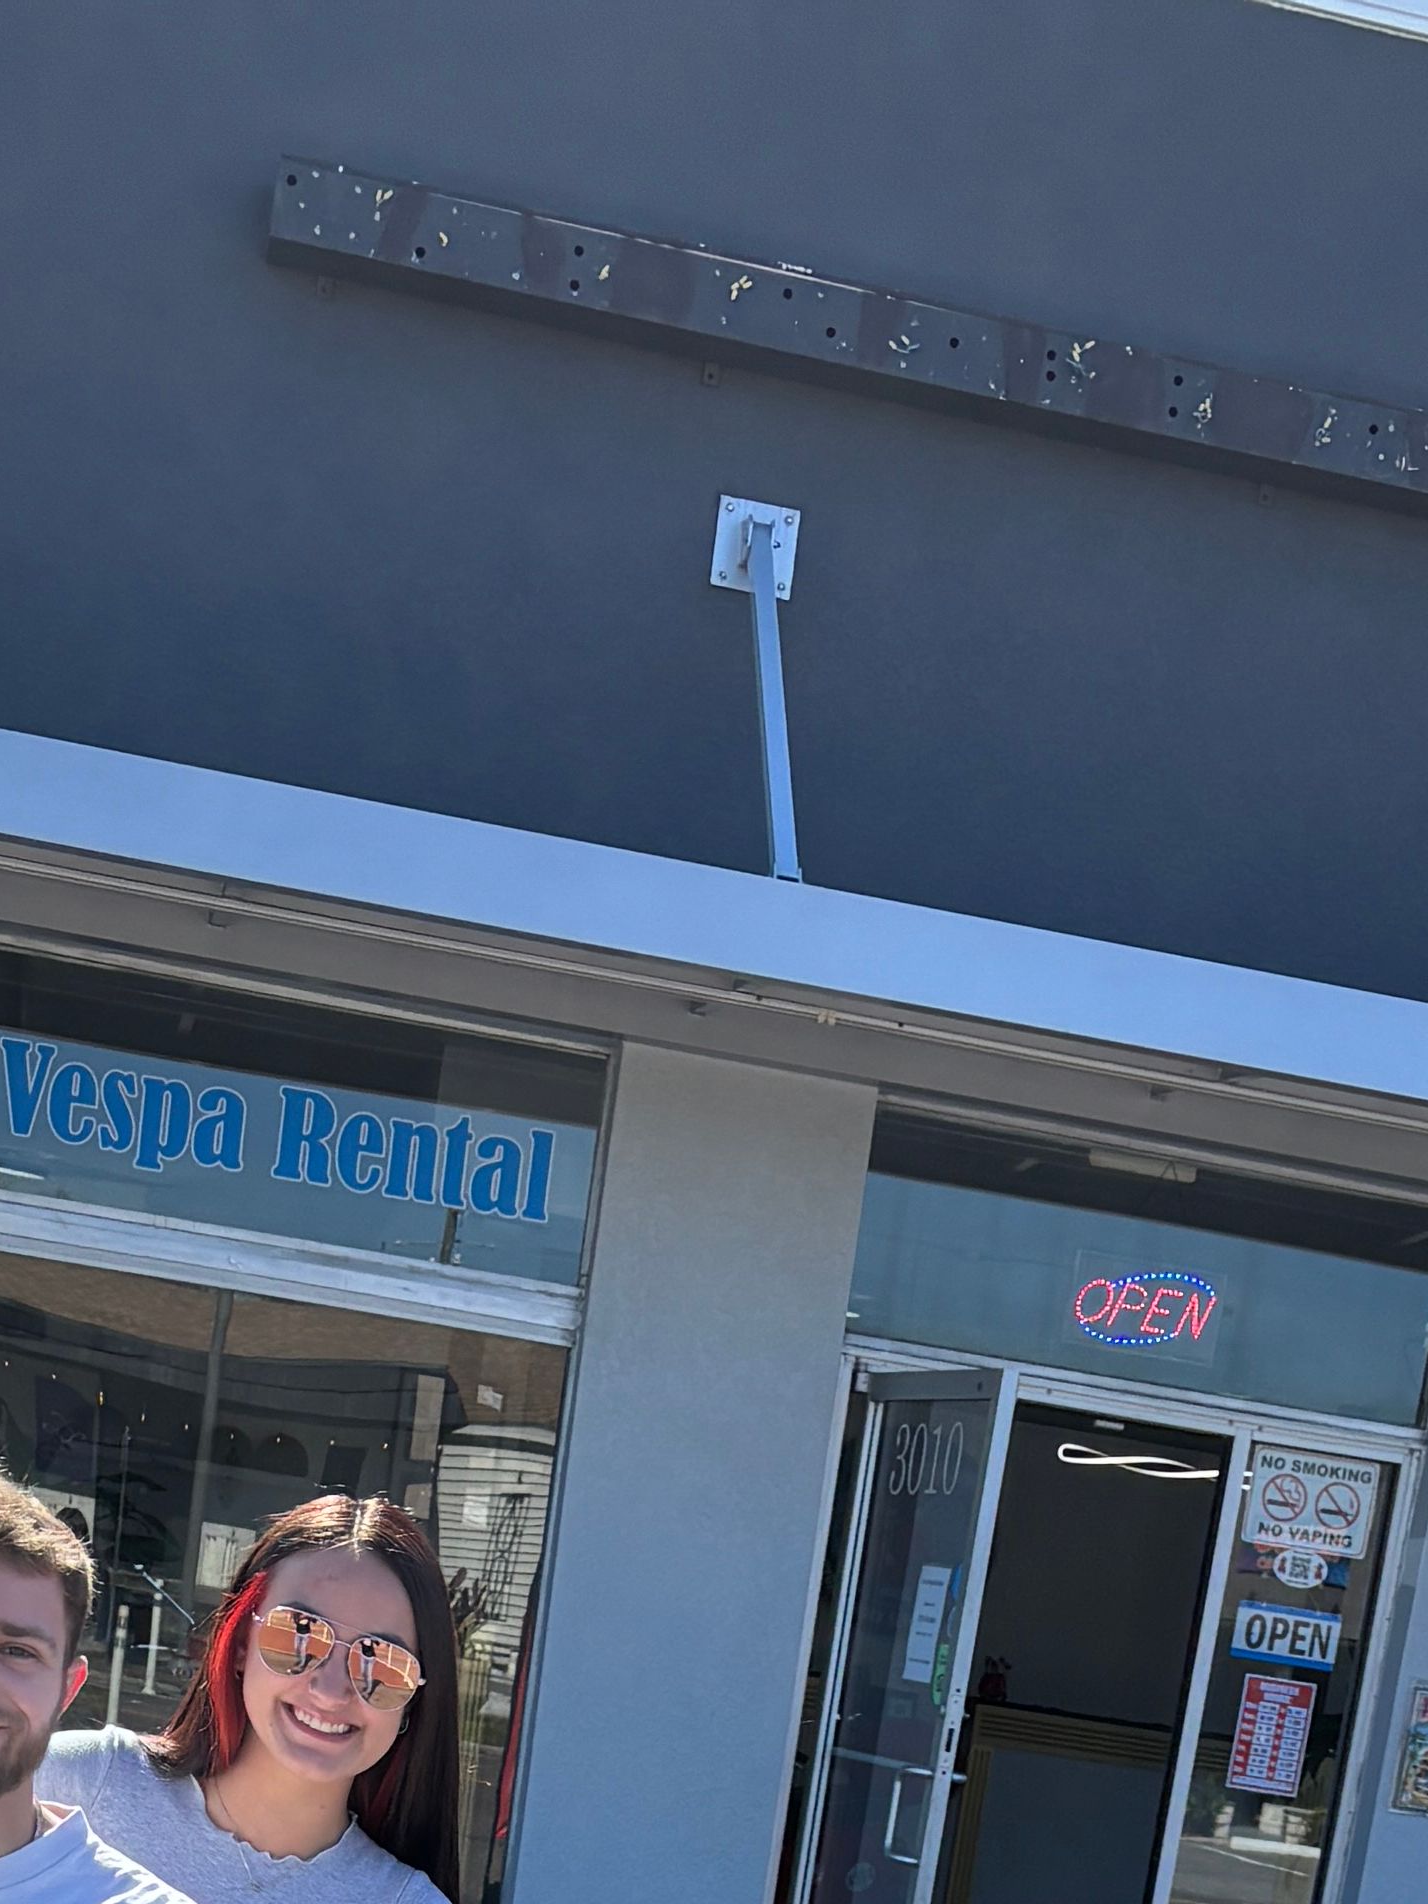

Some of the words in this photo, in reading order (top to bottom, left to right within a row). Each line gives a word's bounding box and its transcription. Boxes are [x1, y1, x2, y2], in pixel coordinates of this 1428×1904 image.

[0, 1037, 247, 1173] Vespa
[272, 1084, 556, 1222] Rental
[1075, 1278, 1217, 1340] OPEN
[888, 1422, 964, 1495] 3010
[1260, 1455, 1286, 1469] NO
[1291, 1460, 1372, 1484] SMOKING
[1258, 1522, 1283, 1537] NO
[1288, 1526, 1352, 1548] VAPING
[1244, 1613, 1333, 1660] OPEN
